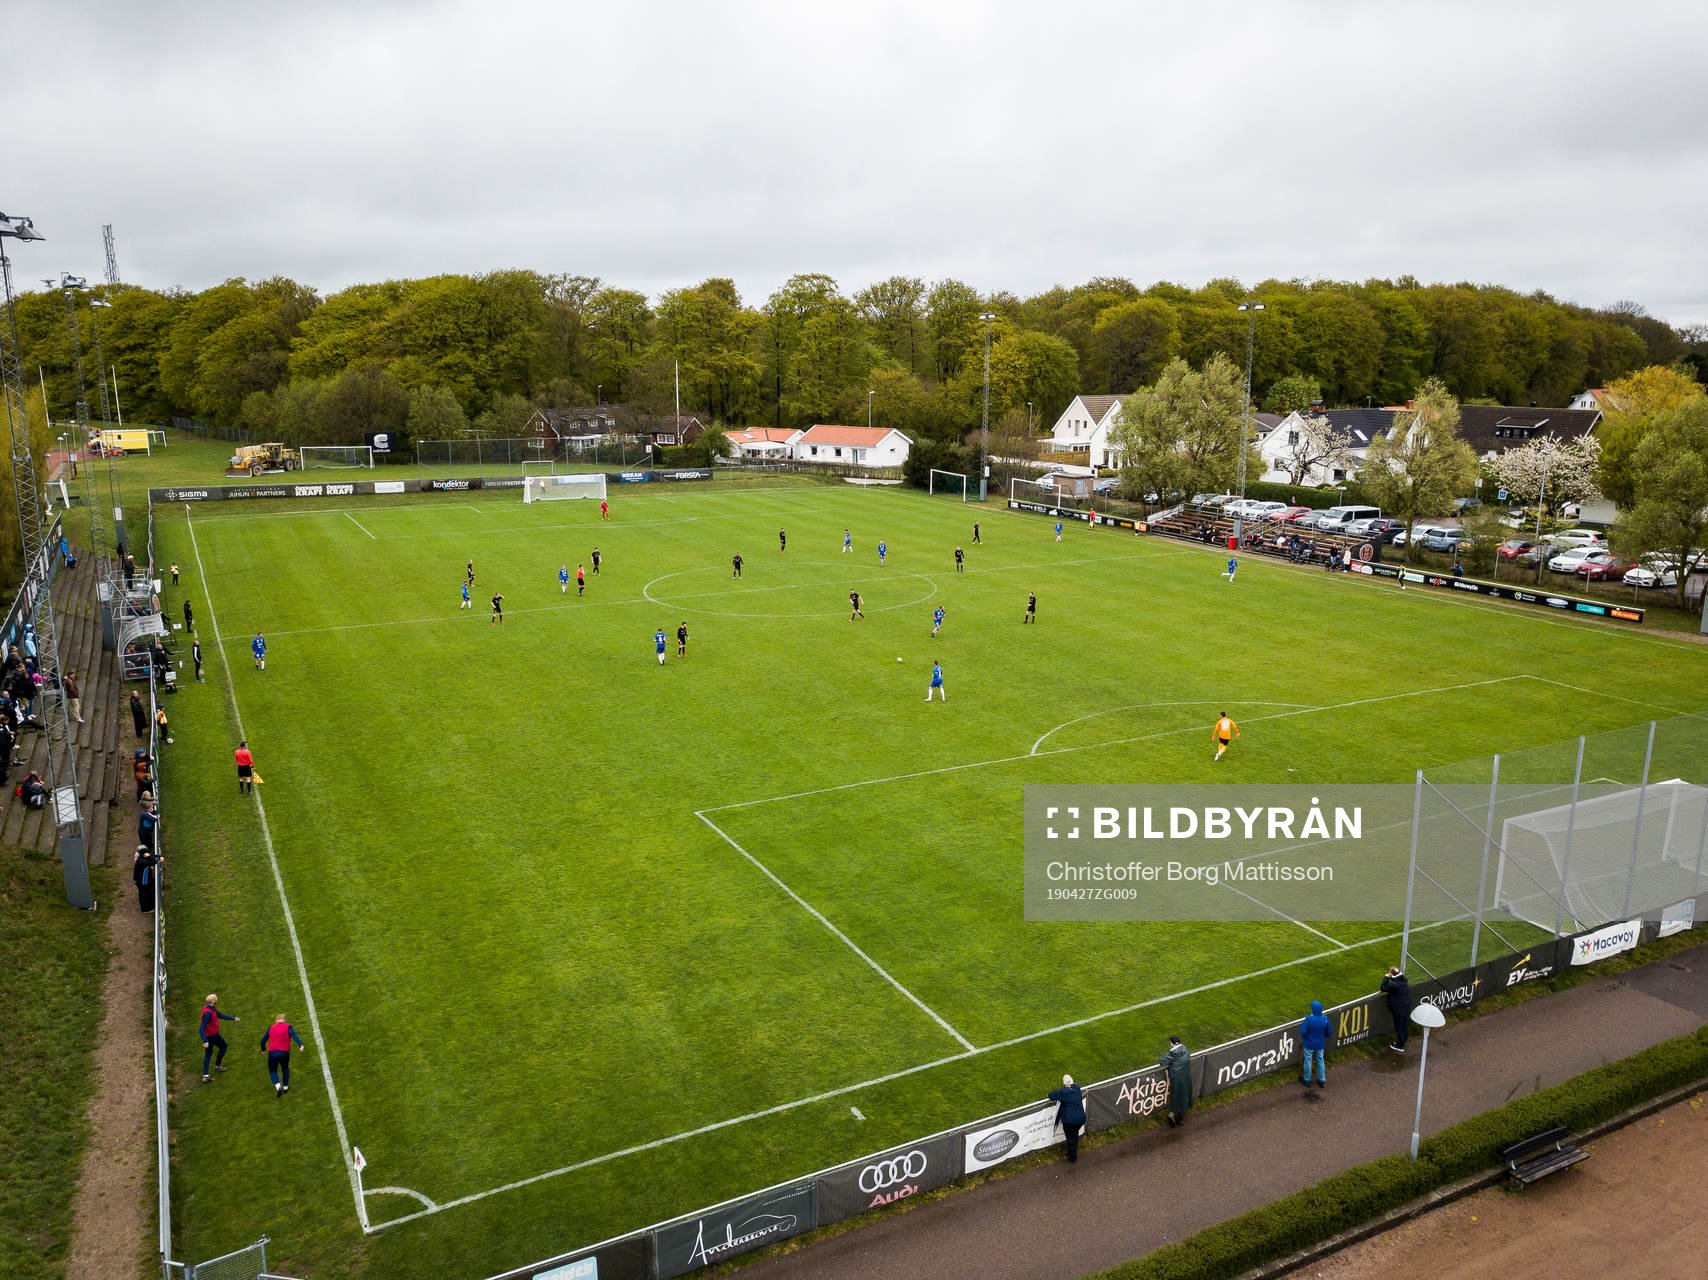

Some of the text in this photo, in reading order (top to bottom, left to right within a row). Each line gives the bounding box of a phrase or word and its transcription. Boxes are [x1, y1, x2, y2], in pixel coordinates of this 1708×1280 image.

[1506, 968, 1527, 987] EY
[1338, 1004, 1370, 1038] KOL
[867, 1184, 919, 1209] Audi
